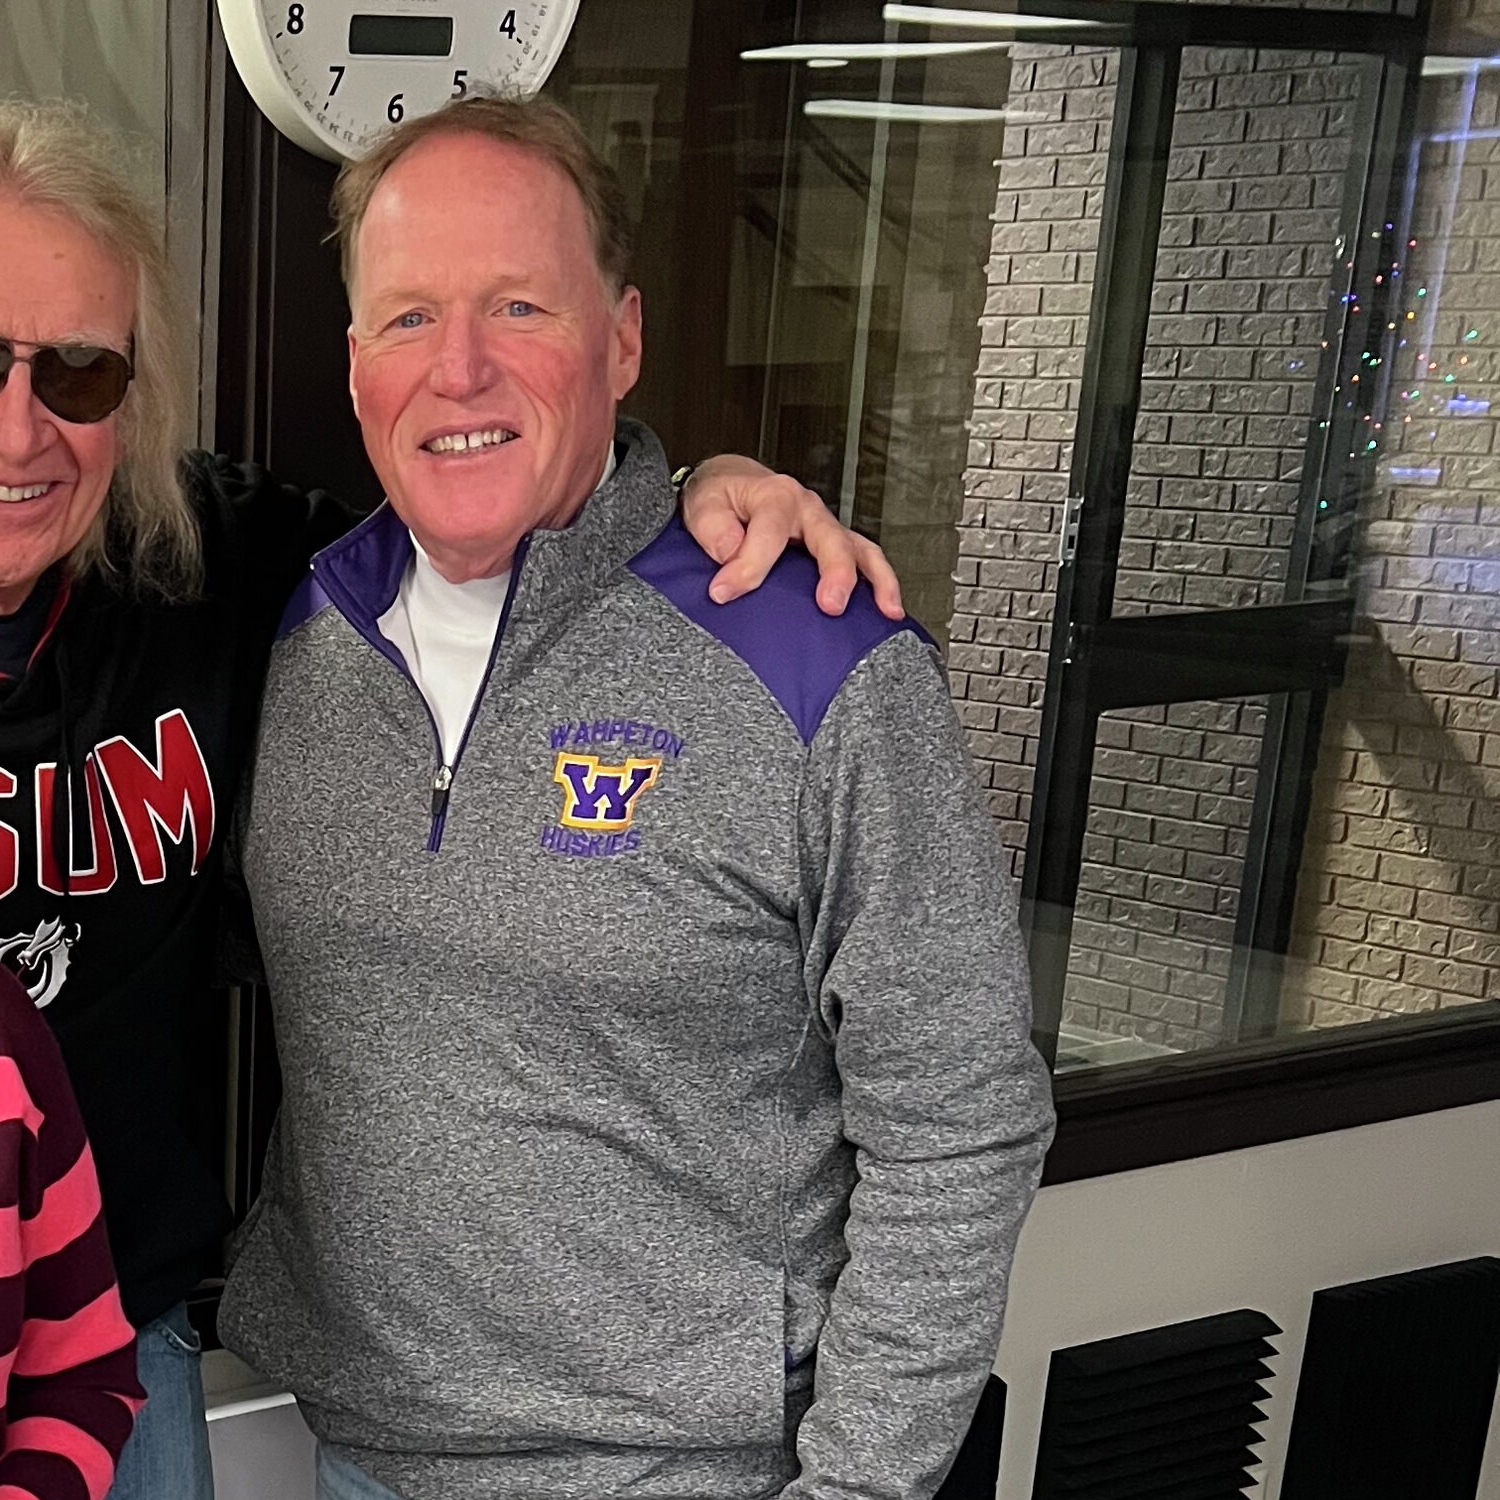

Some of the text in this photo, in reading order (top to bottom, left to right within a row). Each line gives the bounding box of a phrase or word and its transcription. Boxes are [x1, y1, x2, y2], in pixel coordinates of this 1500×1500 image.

[286, 3, 305, 35] 8
[499, 9, 517, 40] 4
[328, 65, 346, 97] 7
[451, 69, 469, 100] 5
[387, 93, 405, 124] 6
[556, 755, 659, 826] W
[540, 825, 643, 859] HUSKIES
